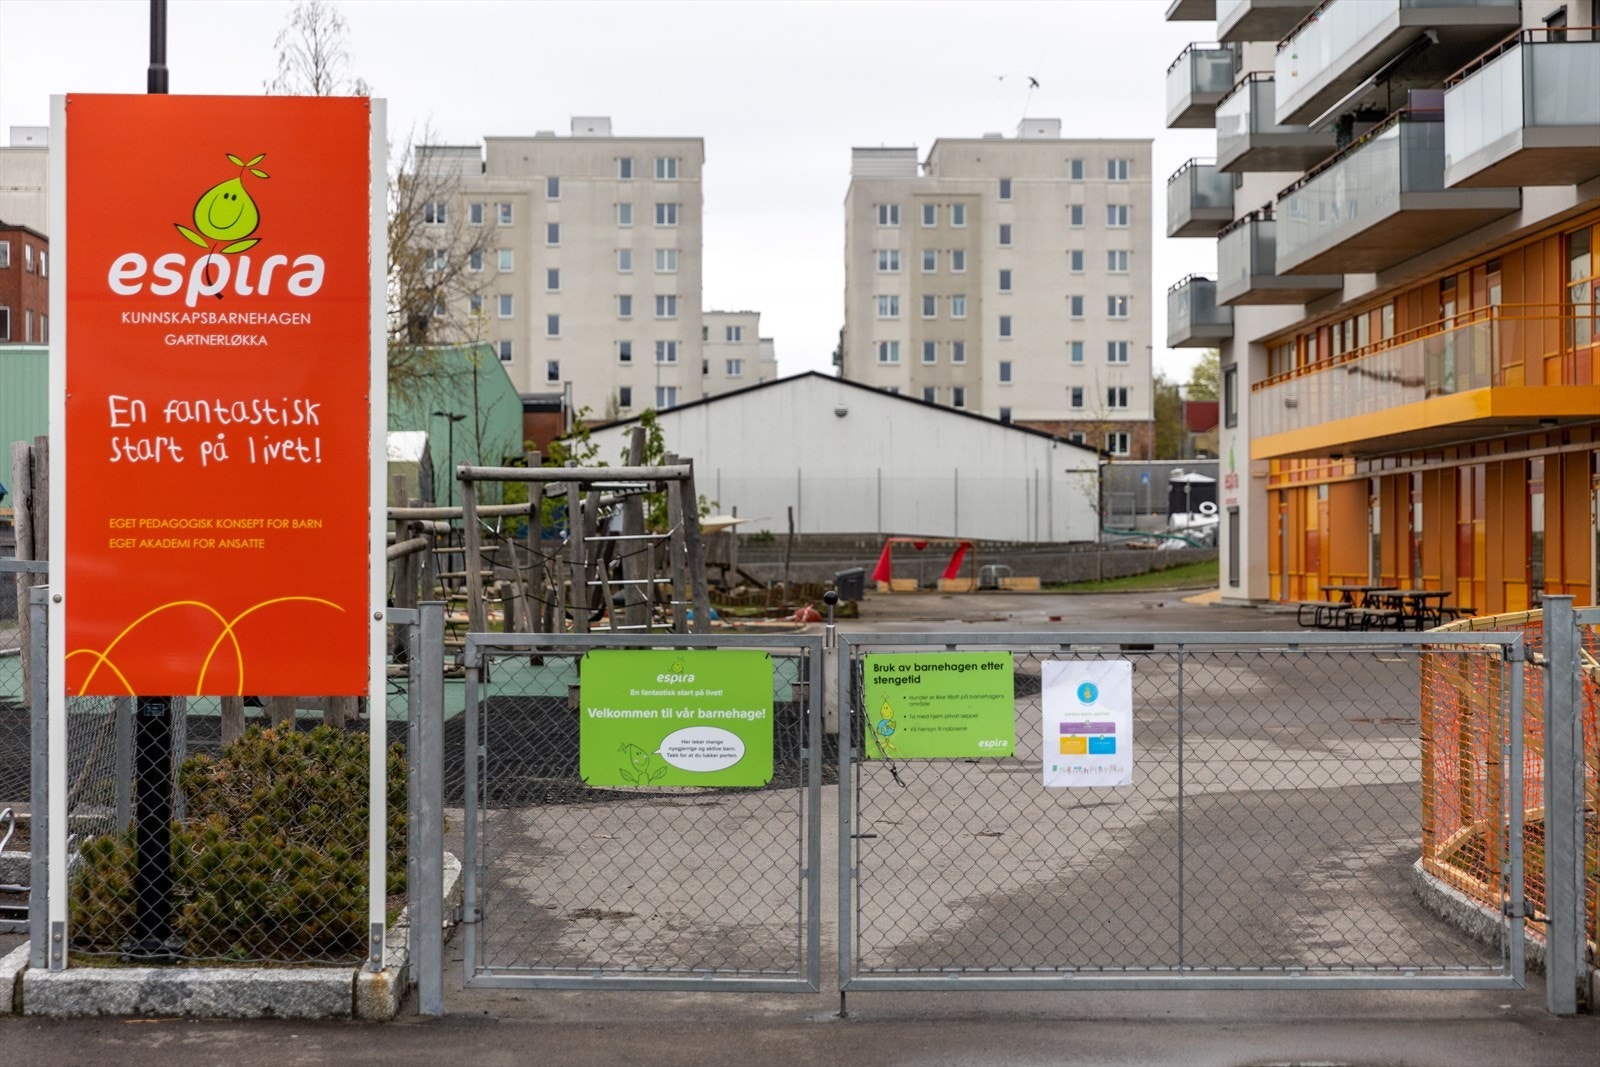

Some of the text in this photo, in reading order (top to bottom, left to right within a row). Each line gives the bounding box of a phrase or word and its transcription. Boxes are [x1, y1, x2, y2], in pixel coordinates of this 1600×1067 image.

[108, 252, 325, 308] espira
[121, 311, 311, 325] KUNNSKAPSBARNEHAGEN
[164, 333, 268, 346] GARTNERLØKKA
[108, 394, 321, 428] En fantastisk
[109, 432, 322, 467] start på livet!
[109, 518, 323, 529] EGET PEDAGOGISK KONSEPT FOR BARN
[109, 538, 265, 549] EGET AKADEMI FOR ANSATTE
[873, 661, 1004, 673] Bruk av barnehagen etter
[656, 673, 696, 685] espira
[873, 674, 921, 686] stengetid
[630, 688, 724, 698] En fantastisk start på livet!
[587, 707, 767, 721] Velkommen til vår barnehage!
[978, 738, 1008, 749] espira
